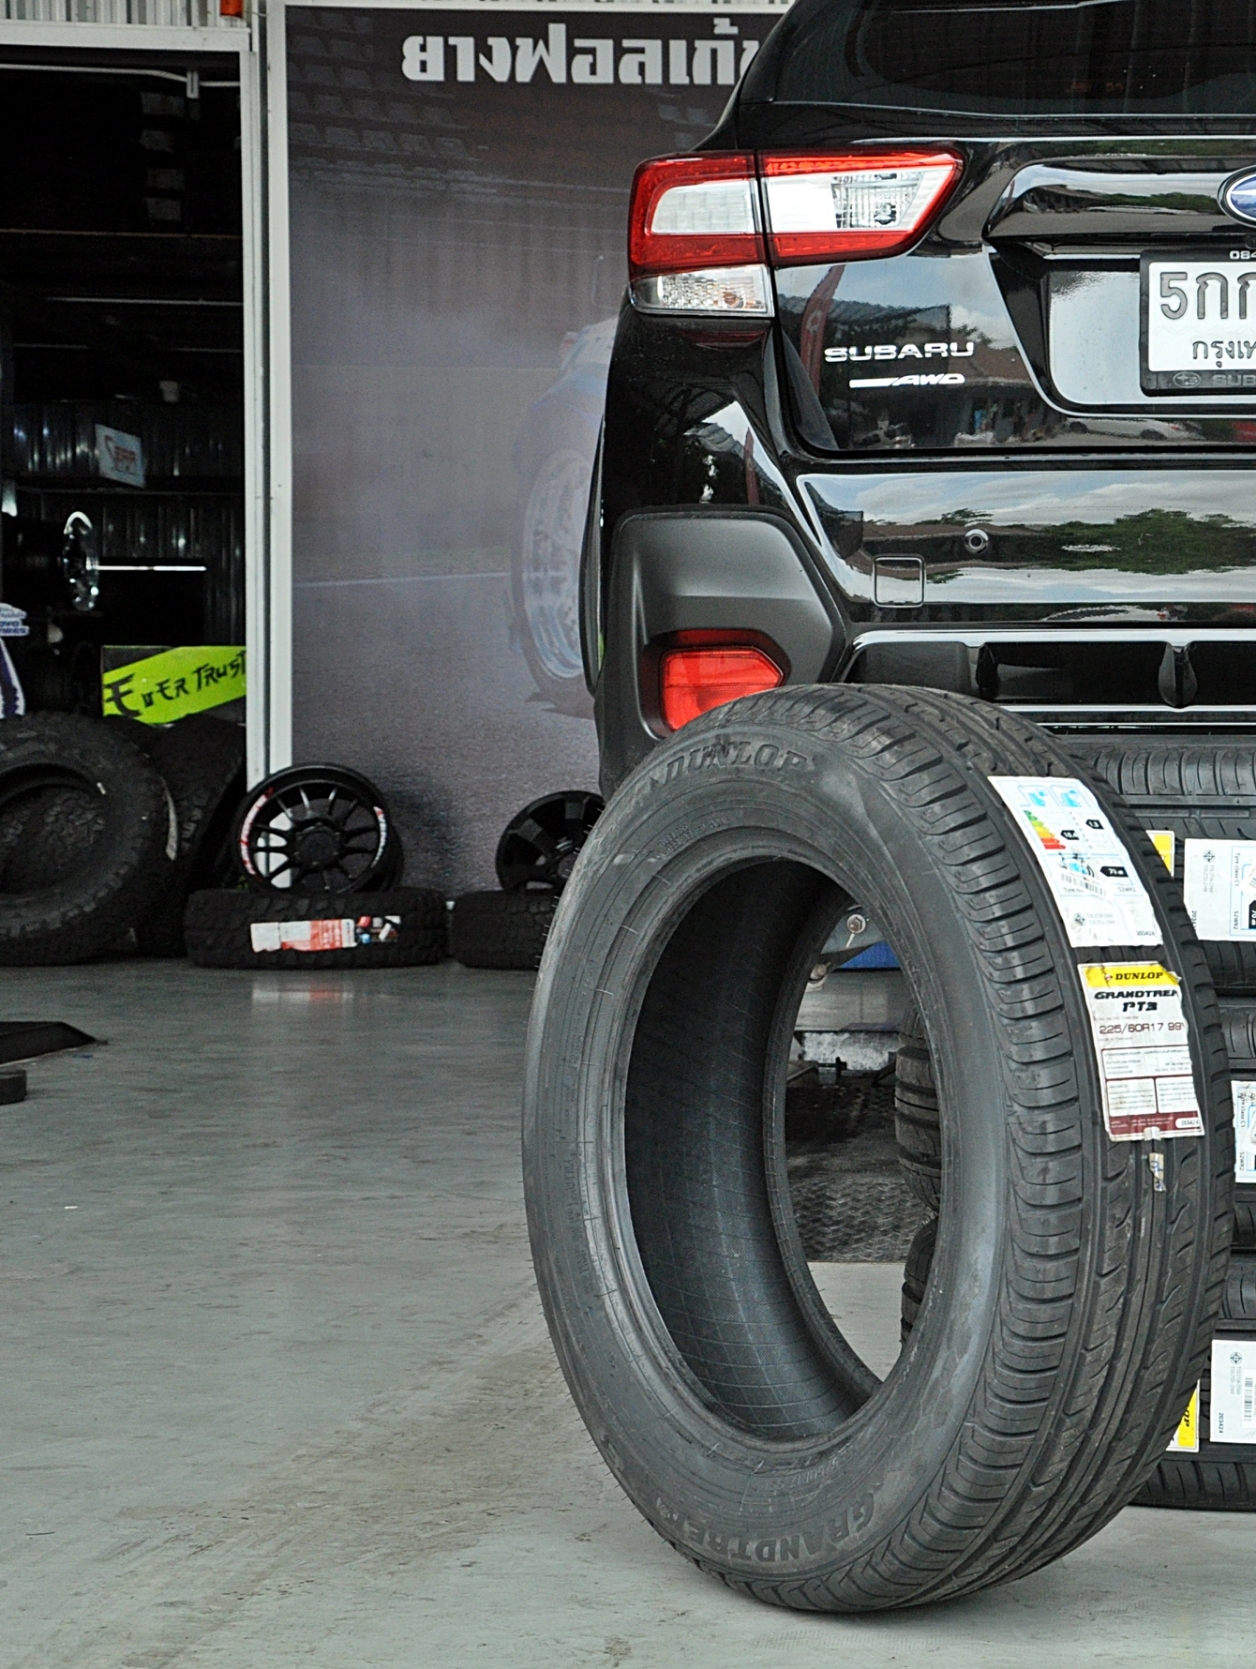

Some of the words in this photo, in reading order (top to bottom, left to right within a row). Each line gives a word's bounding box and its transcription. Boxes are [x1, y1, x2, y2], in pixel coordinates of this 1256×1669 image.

[824, 342, 974, 363] SUBARU
[892, 373, 966, 386] AWD
[664, 741, 809, 786] DUNLOP
[1115, 971, 1163, 980] DUNLOP
[1122, 1001, 1158, 1013] PT3
[1099, 1022, 1164, 1035] 225/60R17
